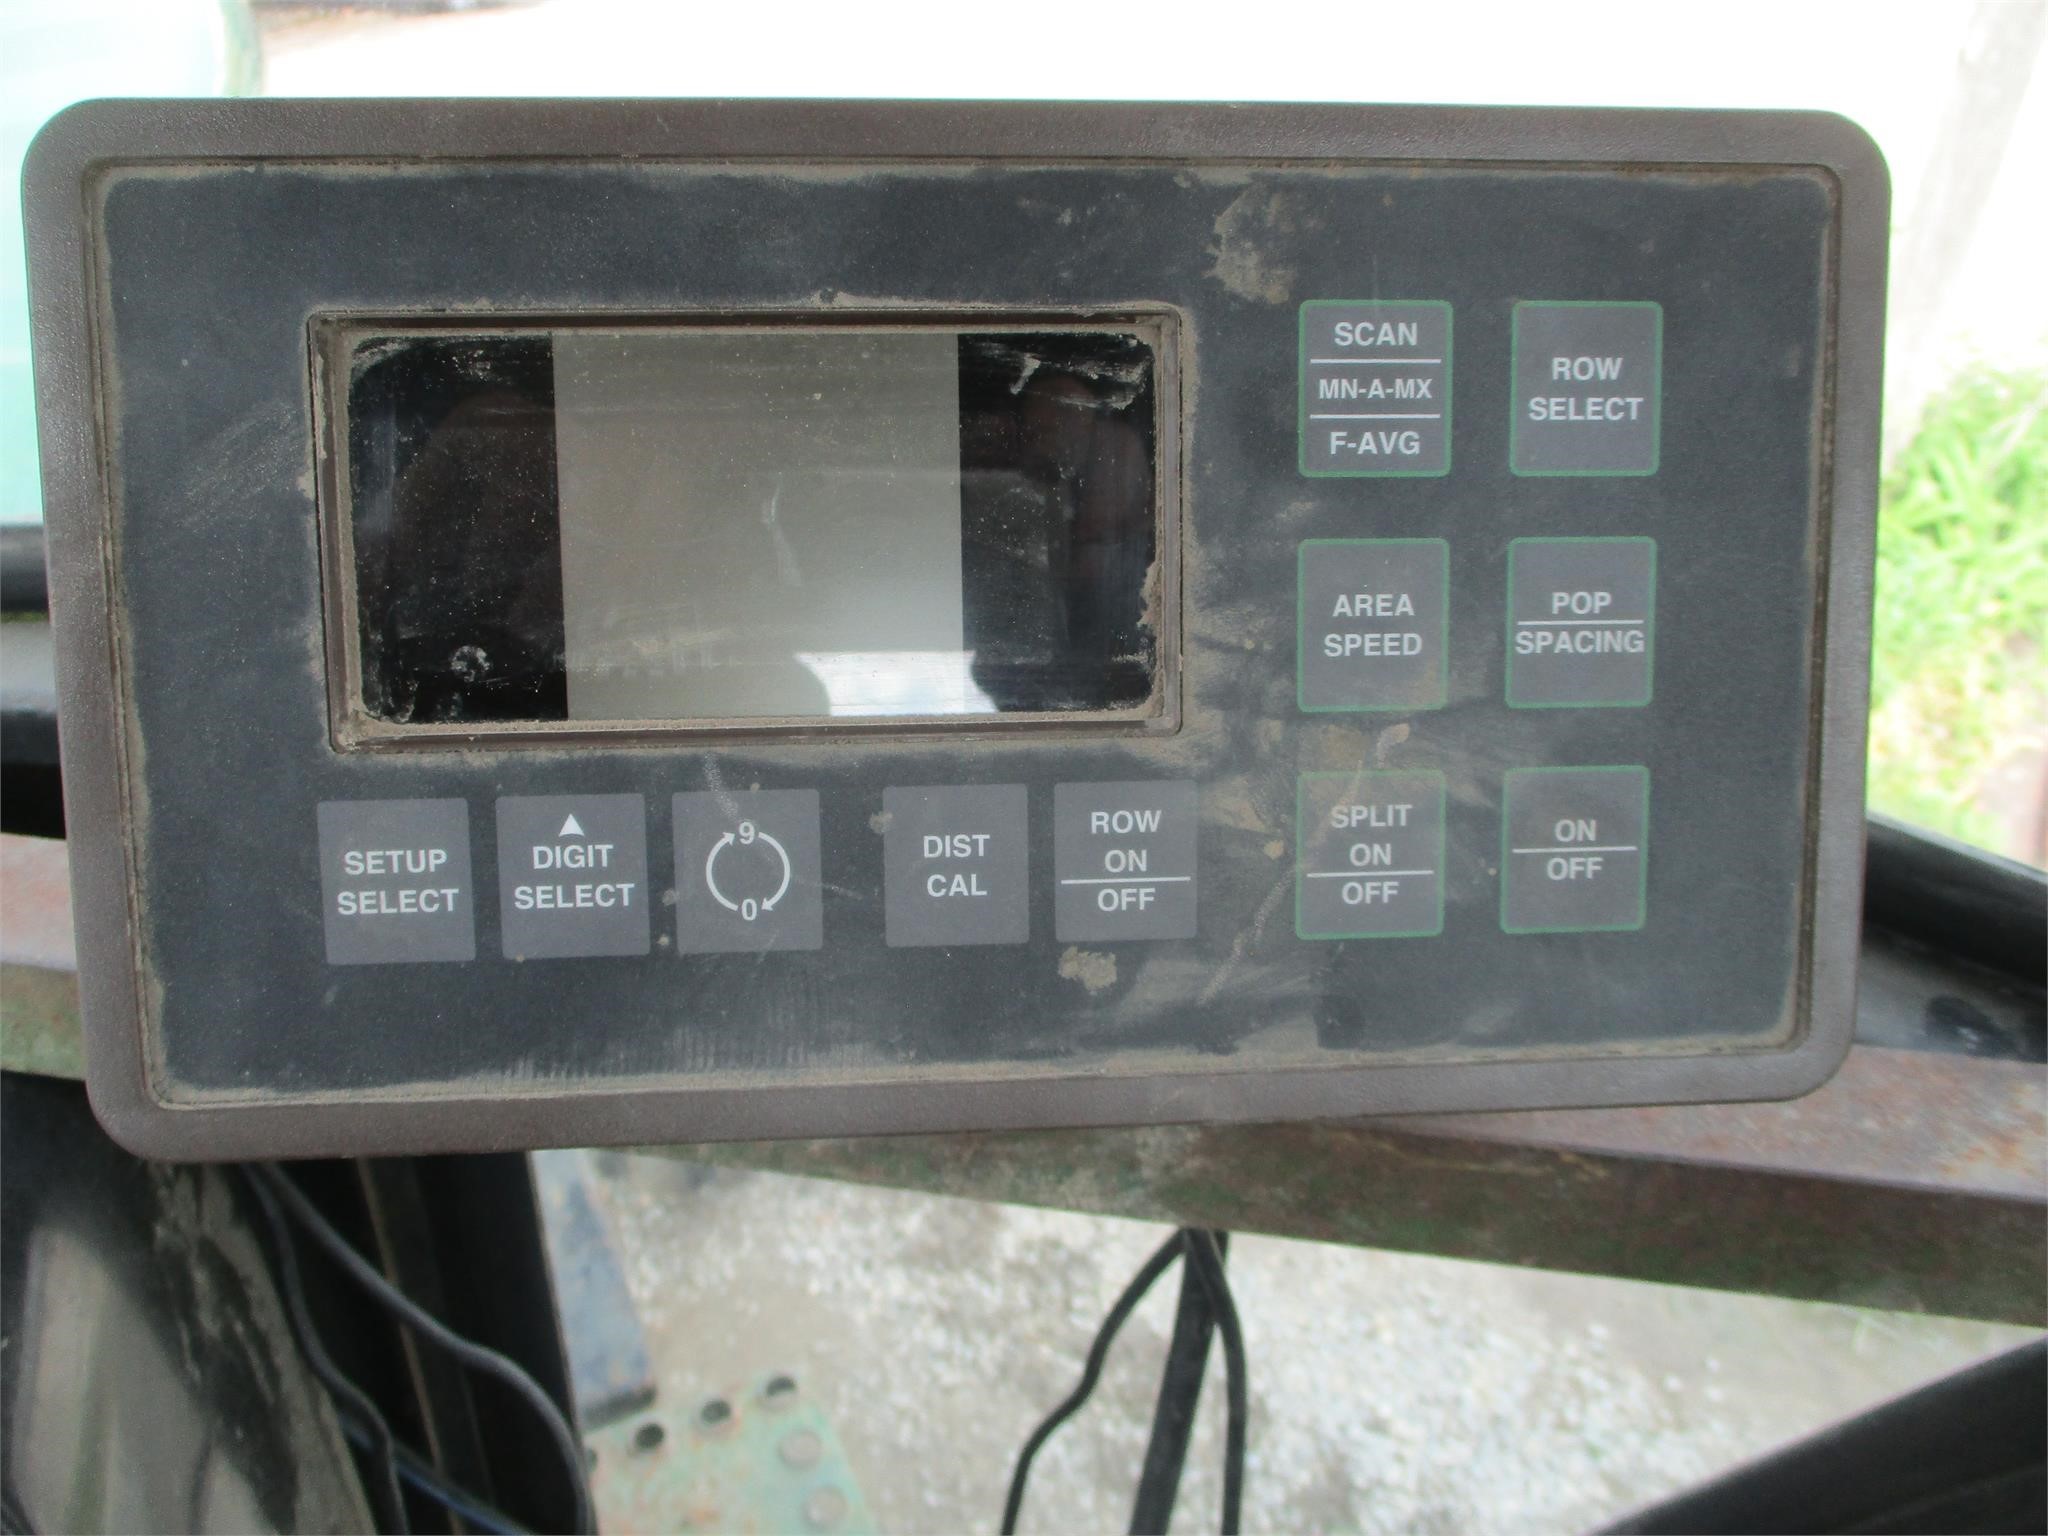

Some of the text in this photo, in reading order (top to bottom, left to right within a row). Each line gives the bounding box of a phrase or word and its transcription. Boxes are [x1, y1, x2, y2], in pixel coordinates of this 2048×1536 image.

[1334, 321, 1418, 347] SCAN
[1551, 356, 1623, 381] ROW
[1318, 378, 1433, 400] MN-A-MX
[1528, 396, 1644, 422] SELECT
[1329, 431, 1421, 456] F-AVG
[1332, 593, 1415, 617] AREA
[1551, 591, 1612, 615] POP
[1323, 632, 1423, 658] SPEED
[1514, 630, 1646, 655] SPACING
[1089, 809, 1162, 835] ROW
[1330, 804, 1413, 830] SPLIT
[738, 821, 756, 845] 9
[1553, 818, 1597, 843] ON
[532, 843, 614, 870] DIGIT
[922, 833, 991, 860] DIST
[1349, 842, 1393, 868] ON
[344, 848, 448, 876] SETUP
[1104, 848, 1149, 873] ON
[1545, 855, 1603, 881] OFF
[513, 883, 636, 910] SELECT
[926, 872, 988, 898] CAL
[1341, 880, 1399, 906] OFF
[337, 888, 460, 916] SELECT
[740, 898, 758, 922] 0
[1097, 886, 1156, 912] OFF
